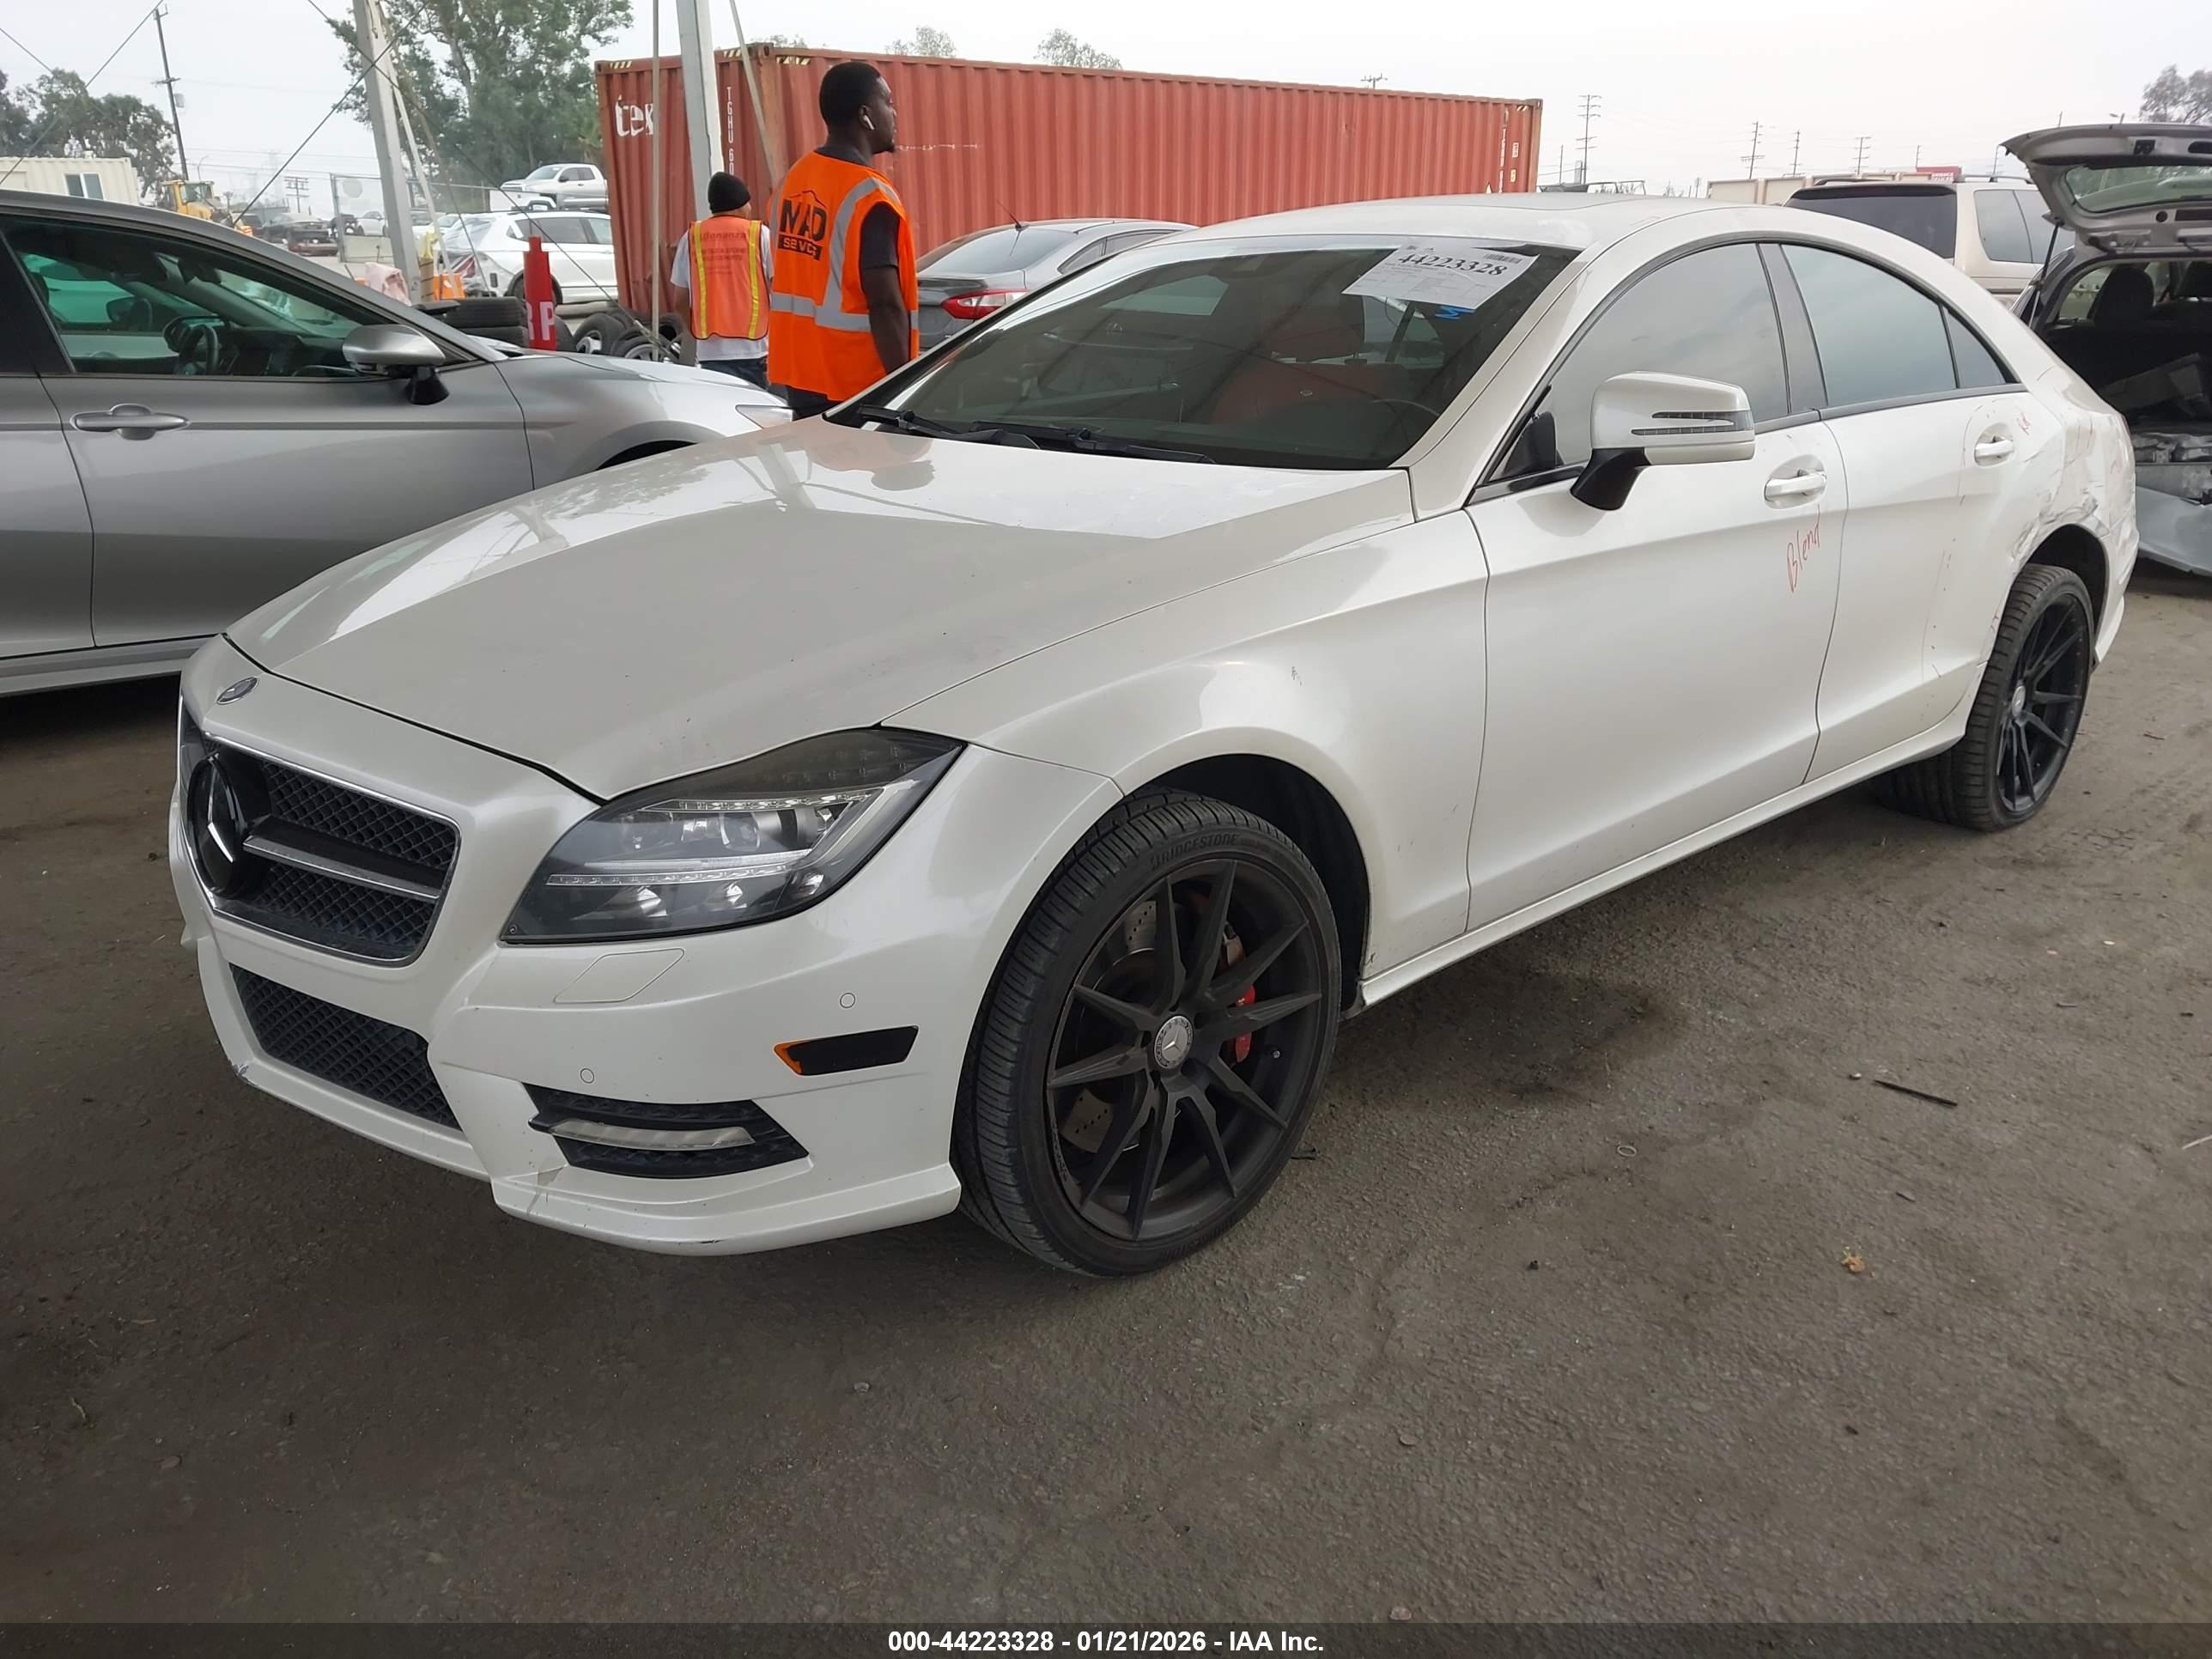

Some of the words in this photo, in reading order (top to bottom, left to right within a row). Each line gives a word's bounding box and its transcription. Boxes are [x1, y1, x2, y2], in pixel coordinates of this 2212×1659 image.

[780, 198, 828, 241] MAD
[1399, 253, 1508, 276] 44223328
[1787, 504, 1820, 592] Blend
